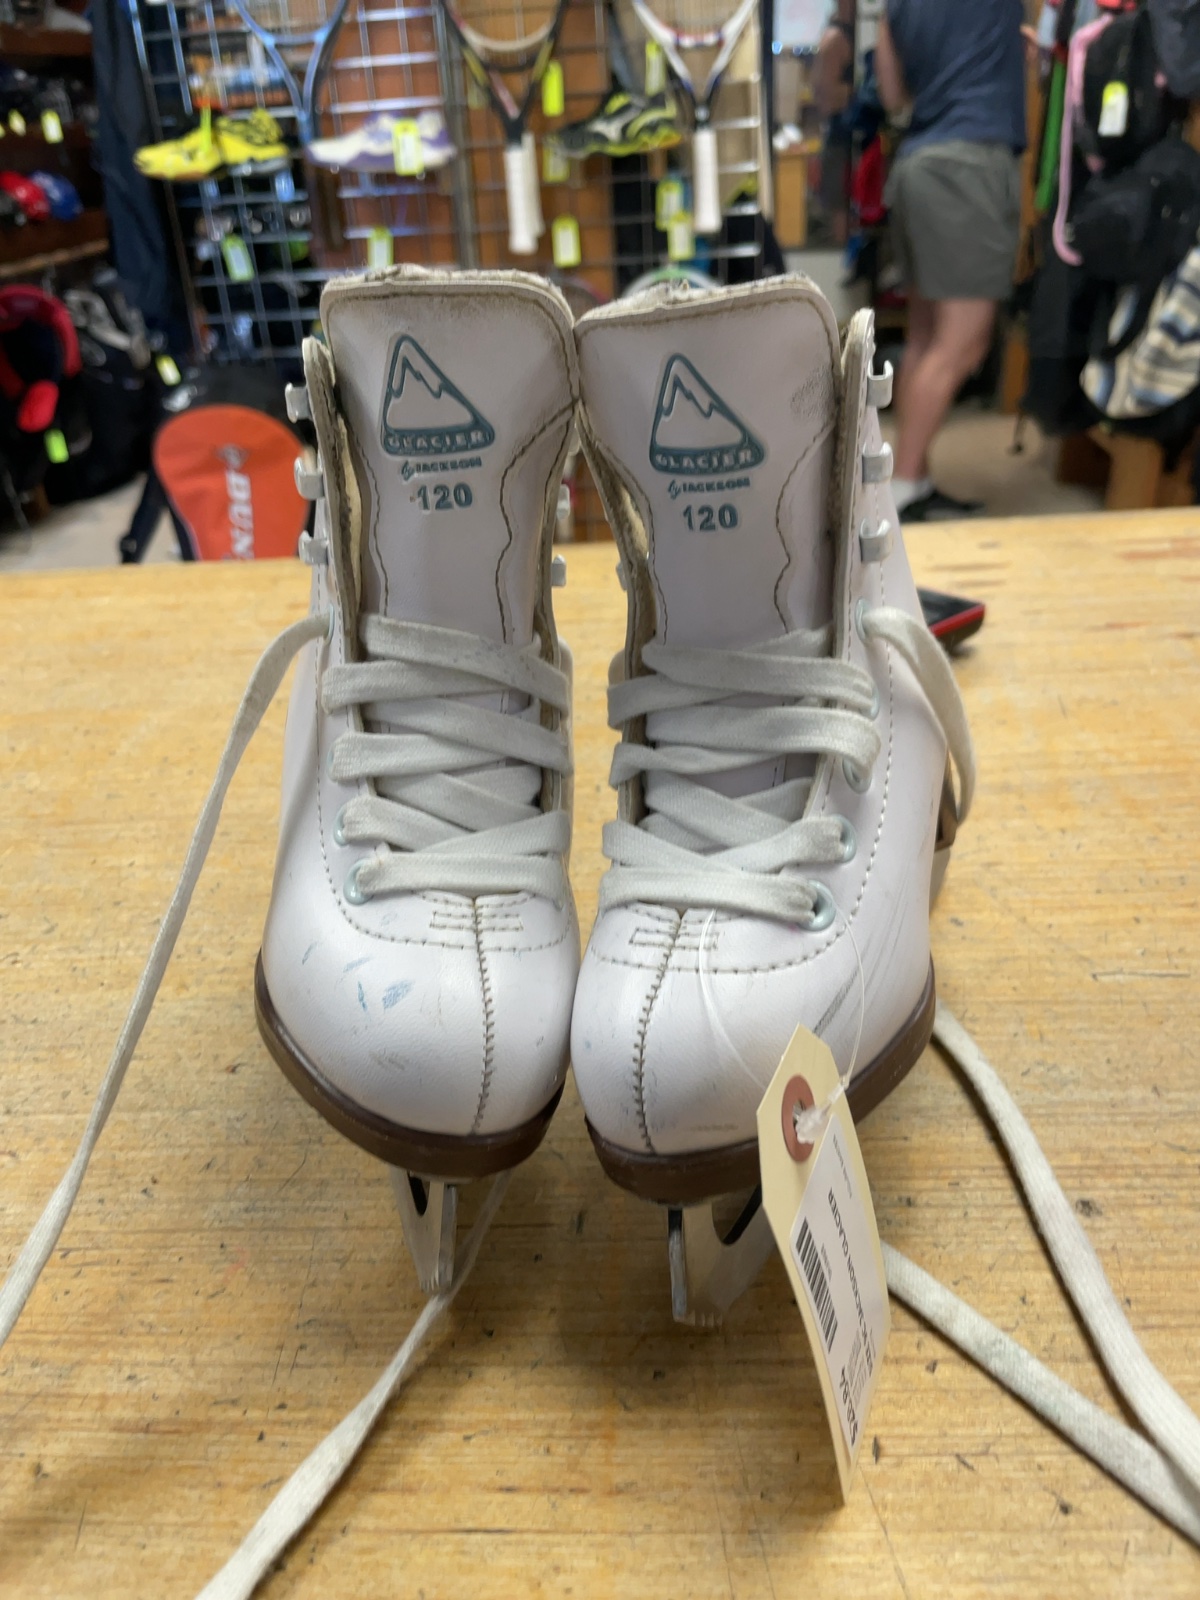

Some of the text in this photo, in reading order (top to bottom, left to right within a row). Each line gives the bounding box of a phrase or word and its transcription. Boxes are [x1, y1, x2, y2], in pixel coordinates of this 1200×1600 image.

[387, 430, 485, 450] GLACIER
[416, 456, 483, 473] JACKSON
[655, 448, 752, 469] GLACIER
[417, 482, 473, 511] 120
[682, 476, 751, 493] JACKSON
[683, 503, 739, 531] 120
[828, 1186, 849, 1258] GLACIER
[846, 1253, 863, 1328] JACKSON
